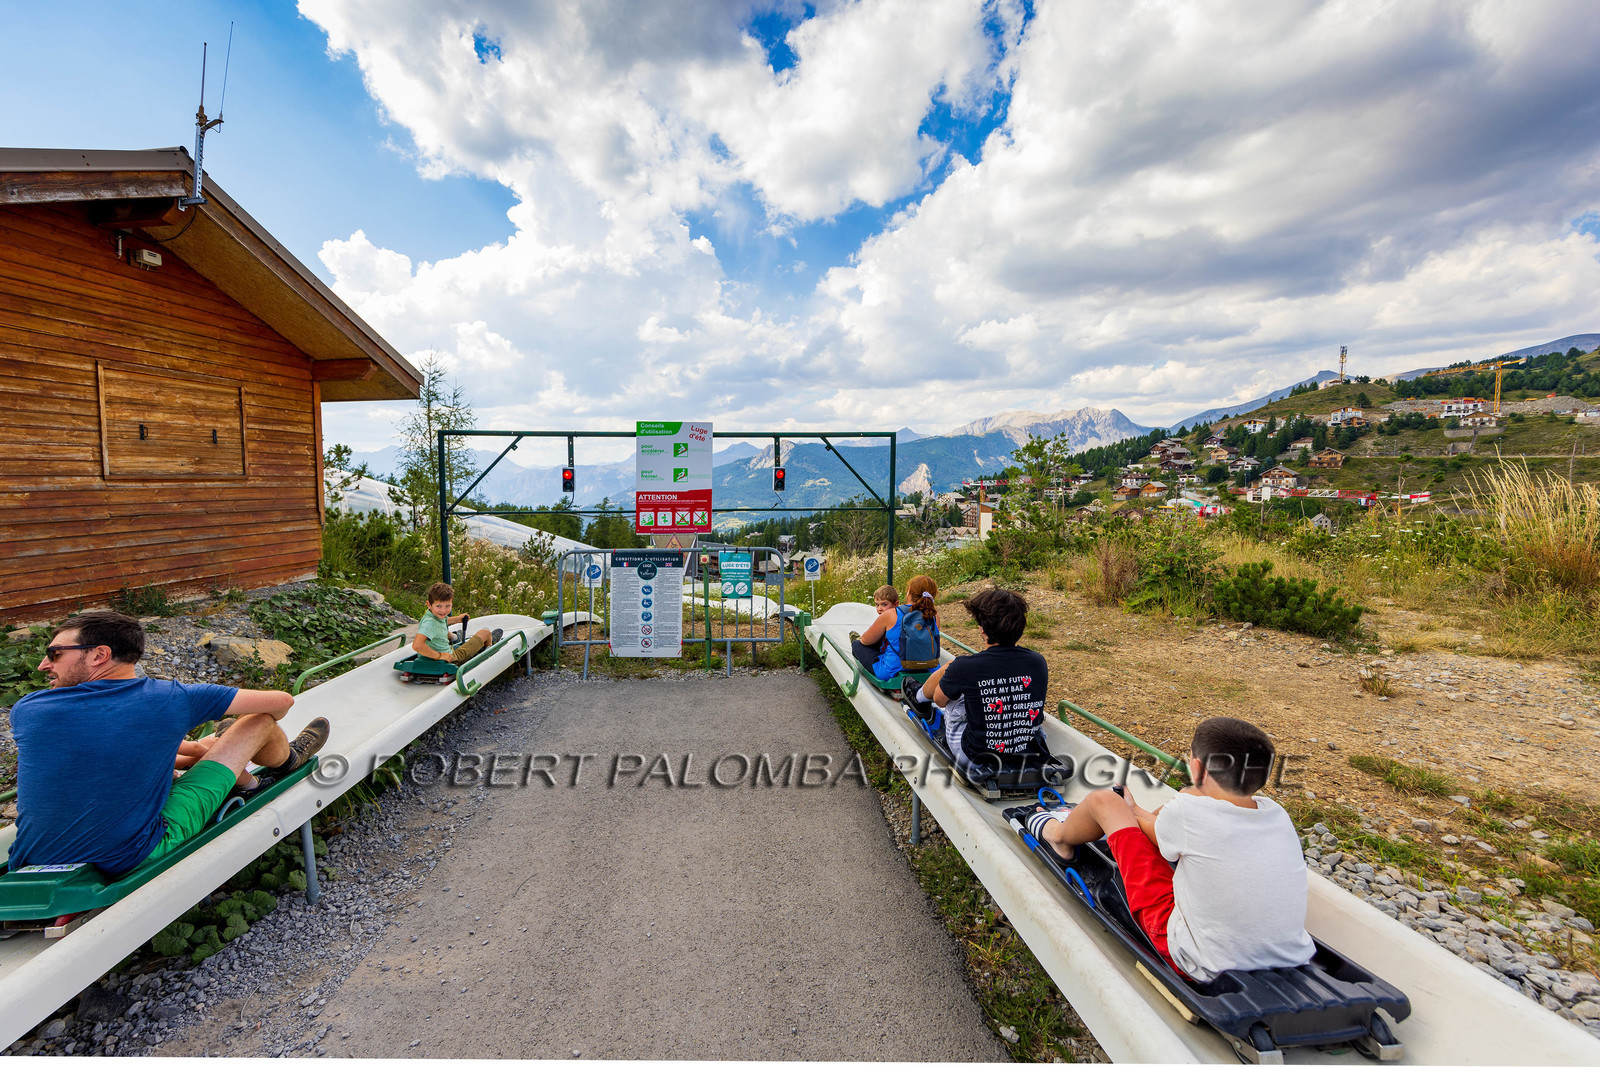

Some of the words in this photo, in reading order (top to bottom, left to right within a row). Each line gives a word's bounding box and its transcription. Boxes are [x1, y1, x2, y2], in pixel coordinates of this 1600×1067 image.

[690, 425, 708, 434] Luge
[689, 433, 706, 442] d'été
[978, 679, 995, 687] LOVE
[1013, 701, 1043, 710] GIRLFRIEND
[1013, 735, 1034, 744] HONEY
